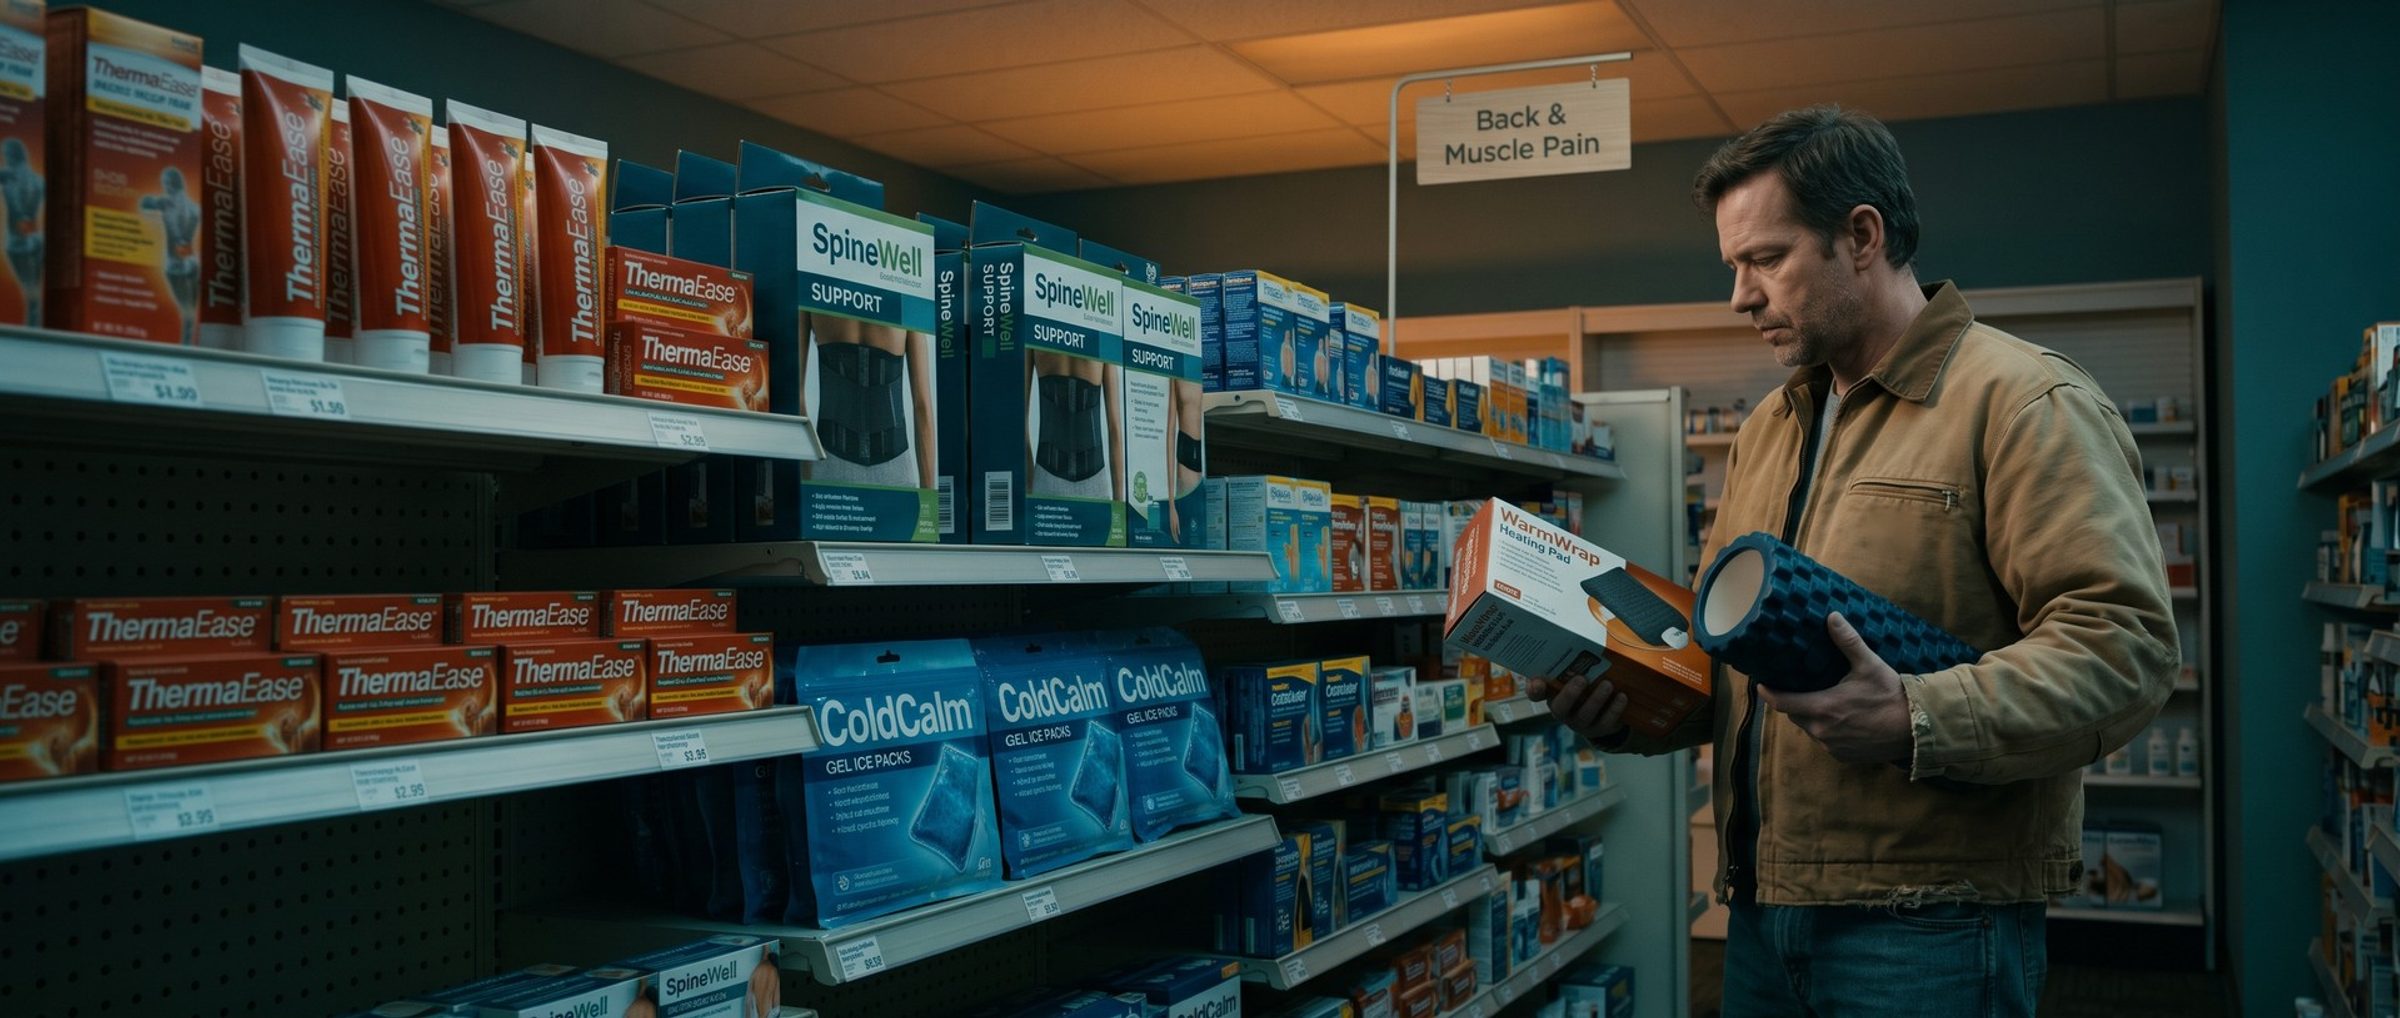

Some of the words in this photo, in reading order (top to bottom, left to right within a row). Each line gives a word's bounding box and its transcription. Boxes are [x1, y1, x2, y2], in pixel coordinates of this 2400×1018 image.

[93, 56, 199, 97] ThermaEase
[1477, 105, 1540, 131] Back
[1548, 103, 1566, 125] &
[1445, 138, 1534, 166] Muscle
[1544, 133, 1600, 158] Pain
[205, 119, 236, 308] ThermaEase
[282, 111, 314, 303] ThermaEase
[389, 136, 421, 316] ThermaEase
[326, 147, 350, 322] ThermaEase
[485, 158, 514, 331] ThermaEase
[813, 222, 923, 278] SpineWell
[567, 178, 595, 342] ThermaEase
[624, 260, 736, 303] ThermaEase
[811, 282, 882, 313] SUPPORT
[983, 263, 995, 336] SUPPORT
[1034, 272, 1115, 317] SpineWell
[936, 270, 955, 358] SpineWell
[997, 261, 1015, 351] SpineWell
[1132, 302, 1196, 341] SpineWell
[641, 335, 752, 374] ThermaEase
[1034, 324, 1086, 349] SUPPORT
[1131, 348, 1175, 371] SUPPORT
[1500, 506, 1601, 568] WarmWrap
[1500, 524, 1546, 554] Heating
[1548, 546, 1571, 565] Pad
[86, 609, 256, 641] ThermaEase
[291, 606, 433, 635] ThermaEase
[471, 602, 590, 629] ThermaEase
[622, 598, 728, 623] ThermaEase
[337, 662, 484, 697] ThermaEase
[513, 654, 635, 684] ThermaEase
[656, 647, 765, 675] ThermaEase
[127, 672, 305, 711] ThermaEase
[998, 675, 1110, 723] ColdCalm
[1117, 662, 1208, 703] ColdCalm
[820, 690, 974, 747] ColdCalm
[1127, 711, 1144, 725] GEL
[1144, 709, 1157, 722] ICE
[1157, 705, 1178, 719] PACKS
[1005, 731, 1028, 747] GEL
[1028, 729, 1044, 744] ICE
[1044, 725, 1072, 740] PACKS
[826, 755, 853, 775] GEL
[854, 753, 874, 771] ICE
[875, 750, 912, 769] PACKS
[666, 961, 737, 998] SpineWell
[531, 996, 608, 1018] eWell
[1178, 995, 1237, 1018] ldCalm
